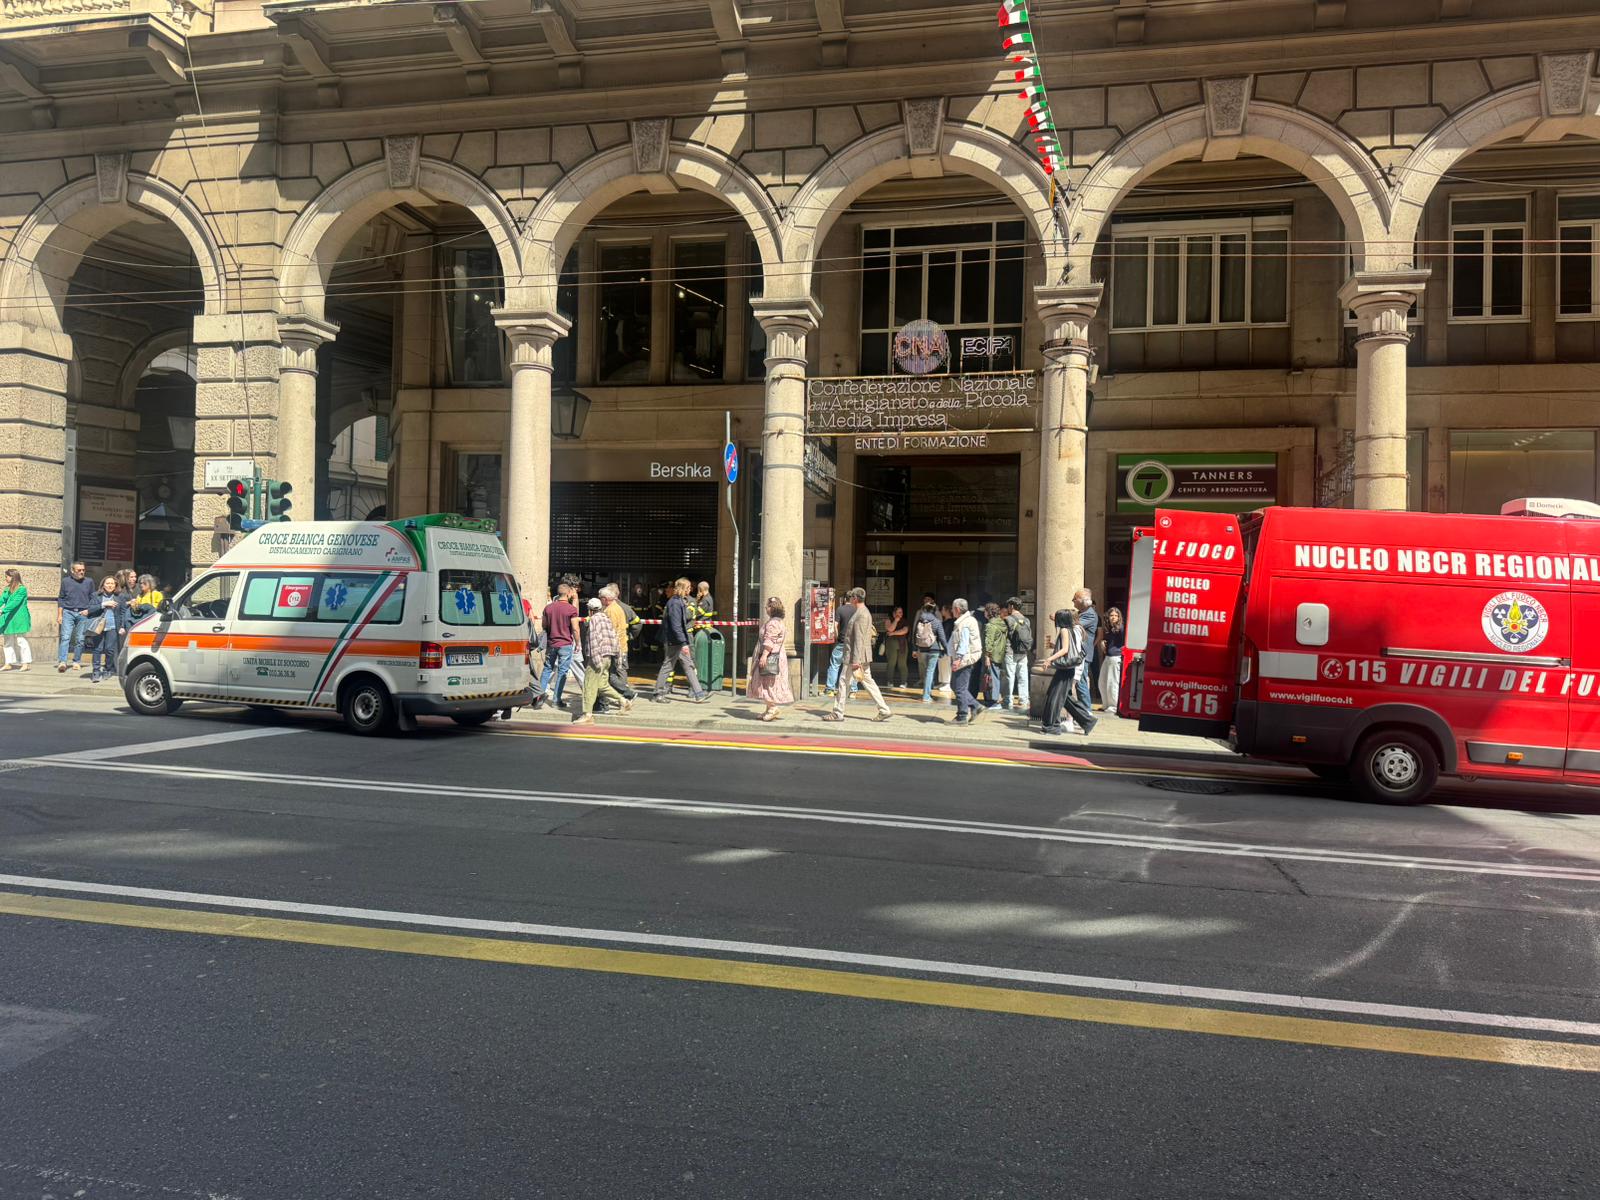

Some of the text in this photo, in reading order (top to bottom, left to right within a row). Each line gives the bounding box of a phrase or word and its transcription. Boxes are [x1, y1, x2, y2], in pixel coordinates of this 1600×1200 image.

[895, 336, 945, 357] CNA
[962, 337, 1014, 355] ECIPA
[810, 375, 1035, 396] Confederazione Nazionale
[965, 392, 1029, 408] Piccola
[819, 414, 873, 428] Media
[876, 413, 947, 430] Impresa
[855, 435, 986, 450] ENTE DI FORMAZIONE
[650, 462, 712, 478] Bershka
[1192, 471, 1253, 480] TANNERS
[258, 533, 380, 547] CROCE BIANCA GENOVESE
[437, 541, 459, 550] CROCE
[459, 542, 481, 552] BIANCA
[268, 546, 364, 556] DISTACCAMENTO CARIGNANO
[1175, 541, 1236, 560] FUOCO
[1295, 544, 1600, 581] NUCLEO NBCR REGIONAL
[1166, 576, 1210, 591] NUCLEO
[1165, 591, 1198, 605] NBCR
[1511, 592, 1536, 606] FUOCO
[1164, 606, 1227, 623] REGIONALE
[1163, 621, 1209, 637] LIGURIA
[258, 658, 277, 666] MOBILE
[283, 659, 310, 668] SOCCORSO
[1345, 660, 1600, 696] 115 VIGILI DEL FU
[1180, 691, 1218, 715] 115
[1269, 691, 1353, 704] www.vigilfuoco.it
